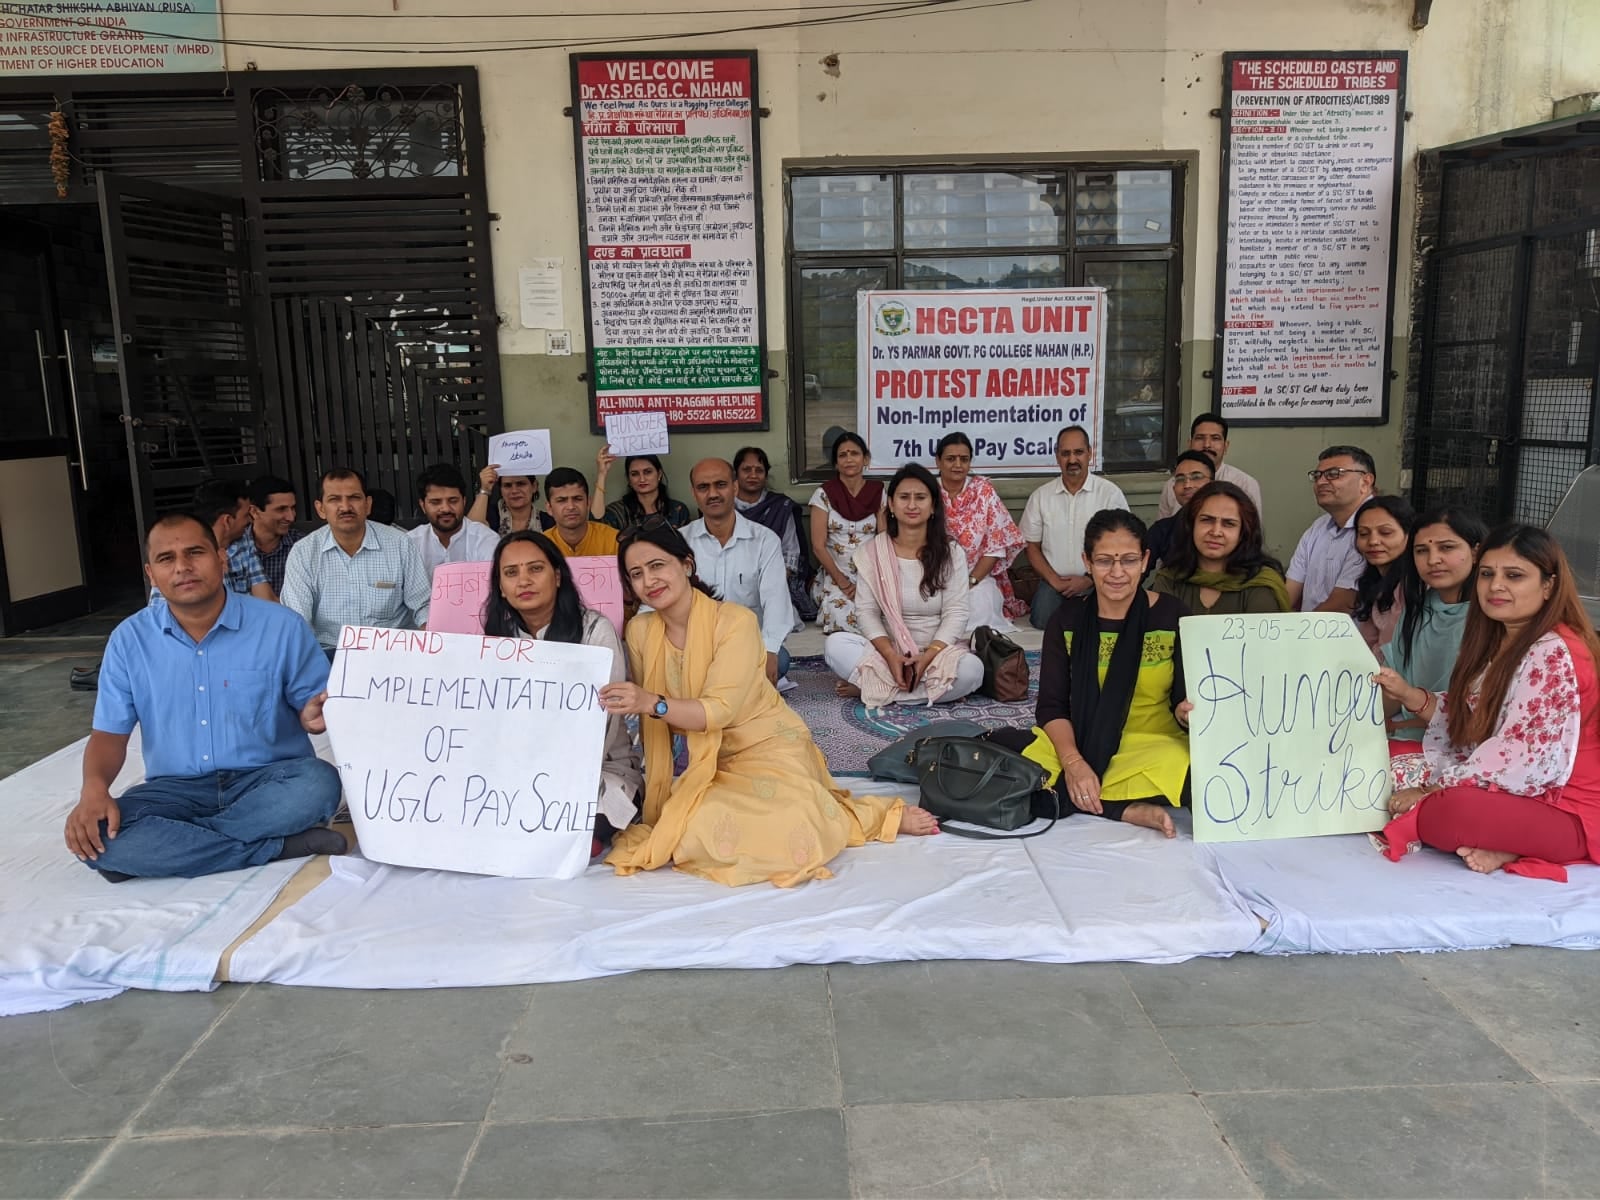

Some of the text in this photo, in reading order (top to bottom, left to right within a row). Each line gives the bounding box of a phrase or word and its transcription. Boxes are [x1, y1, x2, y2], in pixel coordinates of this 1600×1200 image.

[56, 3, 101, 14] SHIKSHA
[106, 1, 155, 13] ABHIYAN
[158, 1, 196, 13] (RUSA)
[78, 17, 93, 27] OF
[95, 16, 127, 27] INDIA
[6, 31, 97, 42] INFRASTRUCTURE
[99, 31, 145, 41] GRANTS
[30, 45, 87, 55] RESOURCE
[90, 44, 169, 55] DEVELOPMENT
[172, 44, 214, 55] (MHRD)
[38, 59, 53, 69] OF
[56, 58, 97, 69] HIGHER
[100, 58, 164, 68] EDUCATION
[606, 60, 714, 81] WELCOME
[1239, 61, 1396, 75] THE SCHEDULED CASTE AND
[690, 81, 743, 97] NAHAN
[1250, 75, 1386, 89] THE SCHEDULED TRIBES
[584, 101, 597, 110] We
[599, 101, 617, 110] feel
[618, 101, 635, 109] Proud
[684, 100, 708, 110] Ragging
[709, 99, 724, 107] Free
[1235, 94, 1292, 106] (PREVENTION
[1293, 95, 1303, 105] OF
[620, 247, 635, 258] का
[639, 246, 685, 259] प्रावधान
[915, 306, 1015, 335] HGCTA
[1022, 305, 1092, 333] UNIT
[872, 343, 1094, 360] Dr. YS PARMAR GOVT. PG COLLEGE NAHAN (H.P.)
[875, 367, 1090, 399] PROTEST AGAINST
[599, 395, 756, 409] ALL-INDIA ANTI-RAGGING HELPLINE
[610, 412, 667, 435] HUNGER
[877, 403, 1087, 428] Non-Implementation of
[611, 431, 668, 452] STRIKE
[893, 439, 922, 457] 7th
[974, 438, 1007, 460] Pay
[1013, 437, 1058, 456] Scal
[1221, 617, 1353, 641] 23-05-2022
[341, 626, 535, 663] DEMAND FOR
[327, 647, 607, 711] IMPLEMENTATION
[1198, 642, 1385, 754] Hunger
[424, 725, 469, 762] OF
[1203, 741, 1389, 835] Strike
